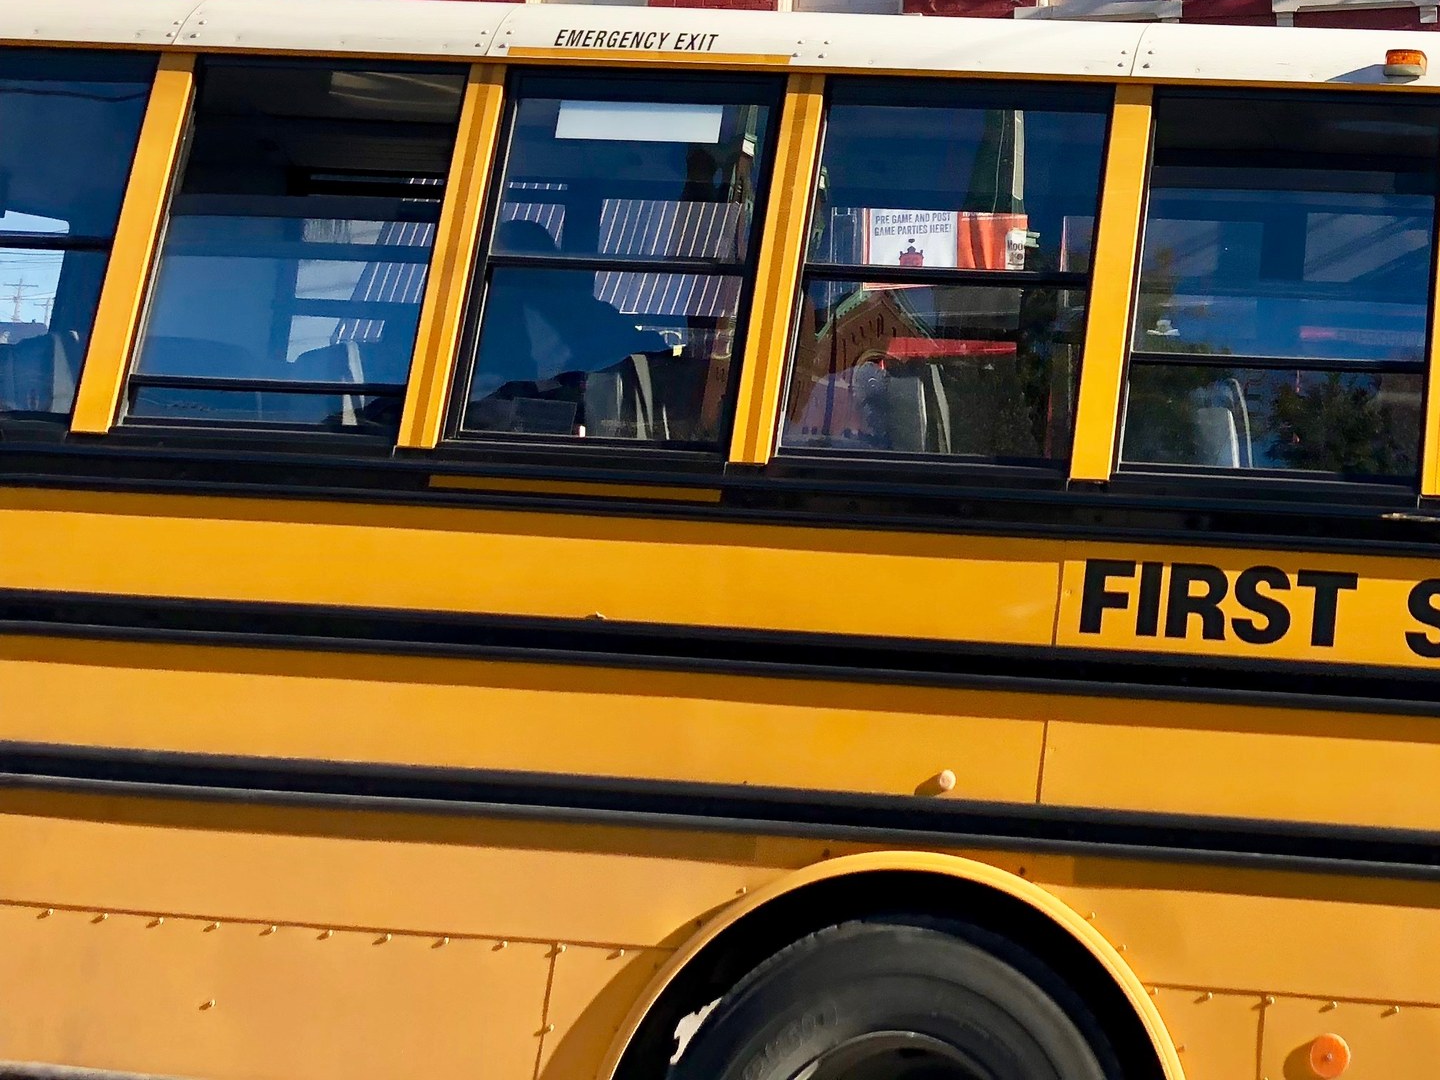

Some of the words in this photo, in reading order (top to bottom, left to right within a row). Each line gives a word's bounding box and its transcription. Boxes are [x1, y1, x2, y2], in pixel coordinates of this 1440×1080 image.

[554, 29, 670, 49] EMERGENCY
[674, 32, 719, 51] EXIT
[875, 215, 890, 224] PRE
[892, 214, 913, 224] GAME
[915, 213, 930, 223] AND
[932, 212, 951, 222] POST
[874, 225, 896, 236] GAME
[898, 224, 928, 235] PARTIES
[1080, 558, 1360, 648] FIRST
